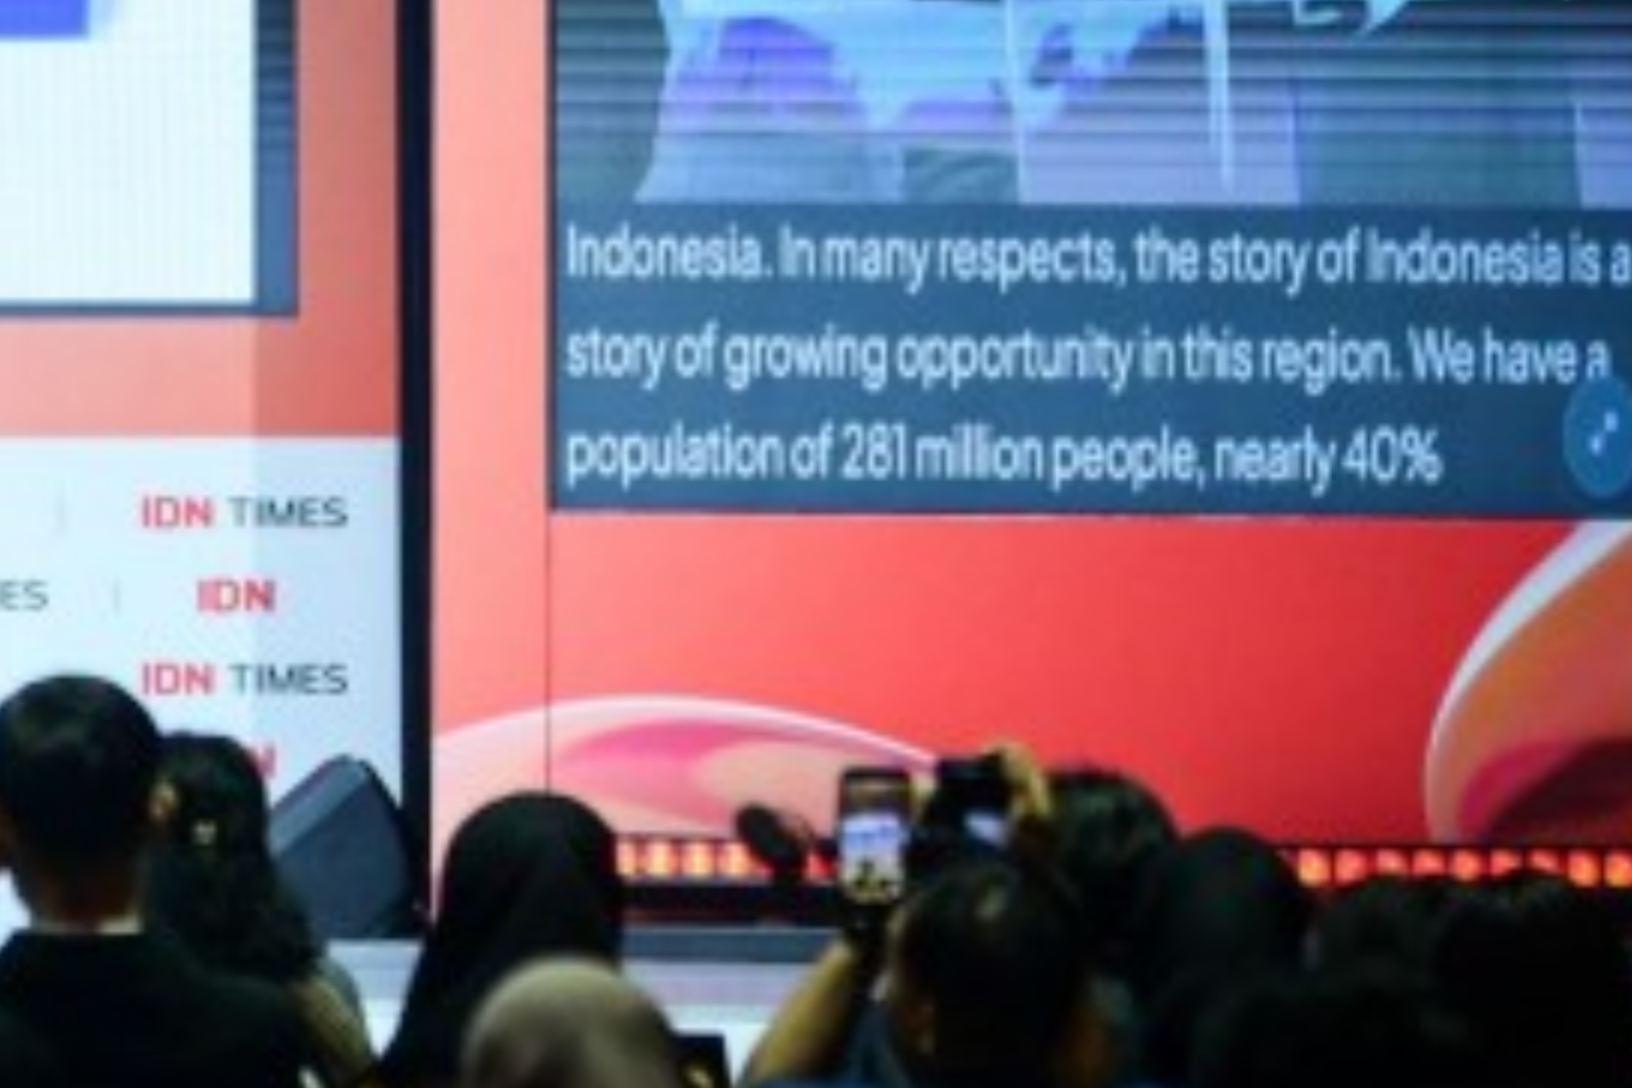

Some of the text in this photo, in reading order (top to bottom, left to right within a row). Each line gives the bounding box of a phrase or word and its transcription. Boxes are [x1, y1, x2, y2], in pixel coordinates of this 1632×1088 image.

[568, 221, 772, 280] Indonesia.
[779, 222, 815, 279] In
[824, 235, 930, 294] many
[940, 228, 1126, 296] respects,
[1134, 225, 1199, 283] the
[1209, 228, 1310, 297] story
[1317, 226, 1363, 284] of
[1368, 227, 1563, 284] Indonesia
[1571, 232, 1600, 284] is
[568, 319, 1610, 396] story of growing opportunity in this region. We have a
[568, 421, 1442, 497] population of 281 million people, nearly 40%
[141, 496, 348, 529] IDN TIMES
[197, 579, 274, 611] IDN
[142, 663, 348, 695] IDN TIMES
